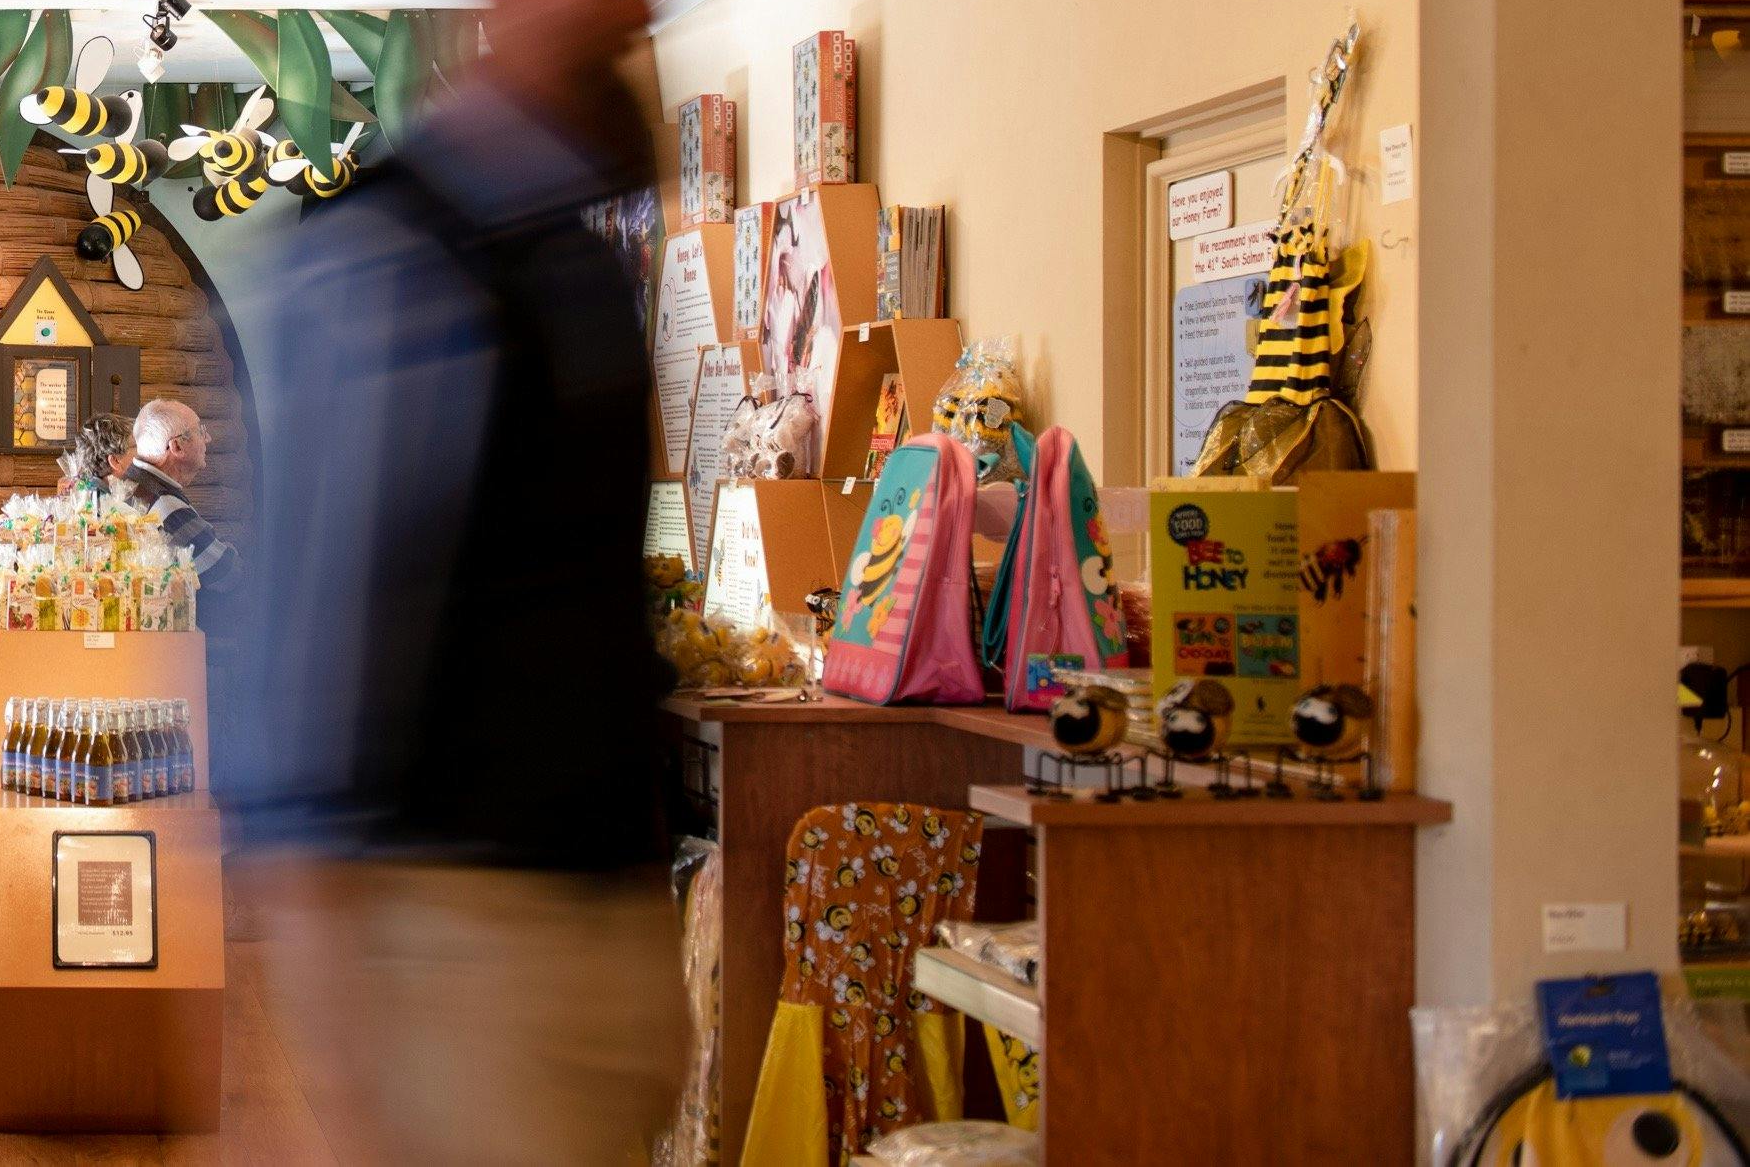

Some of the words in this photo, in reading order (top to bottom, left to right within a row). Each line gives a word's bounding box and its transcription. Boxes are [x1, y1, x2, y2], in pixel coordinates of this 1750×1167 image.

[832, 32, 842, 71] 1000
[844, 41, 853, 79] 1000
[712, 95, 721, 129] 1000
[1172, 195, 1185, 208] Have
[1188, 193, 1198, 206] you
[1200, 184, 1223, 204] enjoyed
[1172, 216, 1181, 227] our
[1183, 211, 1200, 225] Honey
[1203, 204, 1222, 220] Farm?
[1200, 241, 1210, 254] We
[1212, 235, 1246, 252] recommend
[1248, 234, 1259, 247] you
[1195, 262, 1205, 274] the
[1208, 257, 1219, 272] 41°
[1222, 255, 1239, 270] South
[1243, 251, 1265, 266] Salmon
[1195, 298, 1211, 309] Smoked
[1211, 296, 1227, 307] Salmon
[1228, 293, 1244, 304] Tasting
[1200, 314, 1216, 324] working
[1185, 329, 1195, 339] Feed
[1204, 328, 1219, 337] salmon
[1175, 519, 1203, 532] FOOD
[1186, 539, 1225, 566] BEE
[1182, 565, 1249, 591] HONEY
